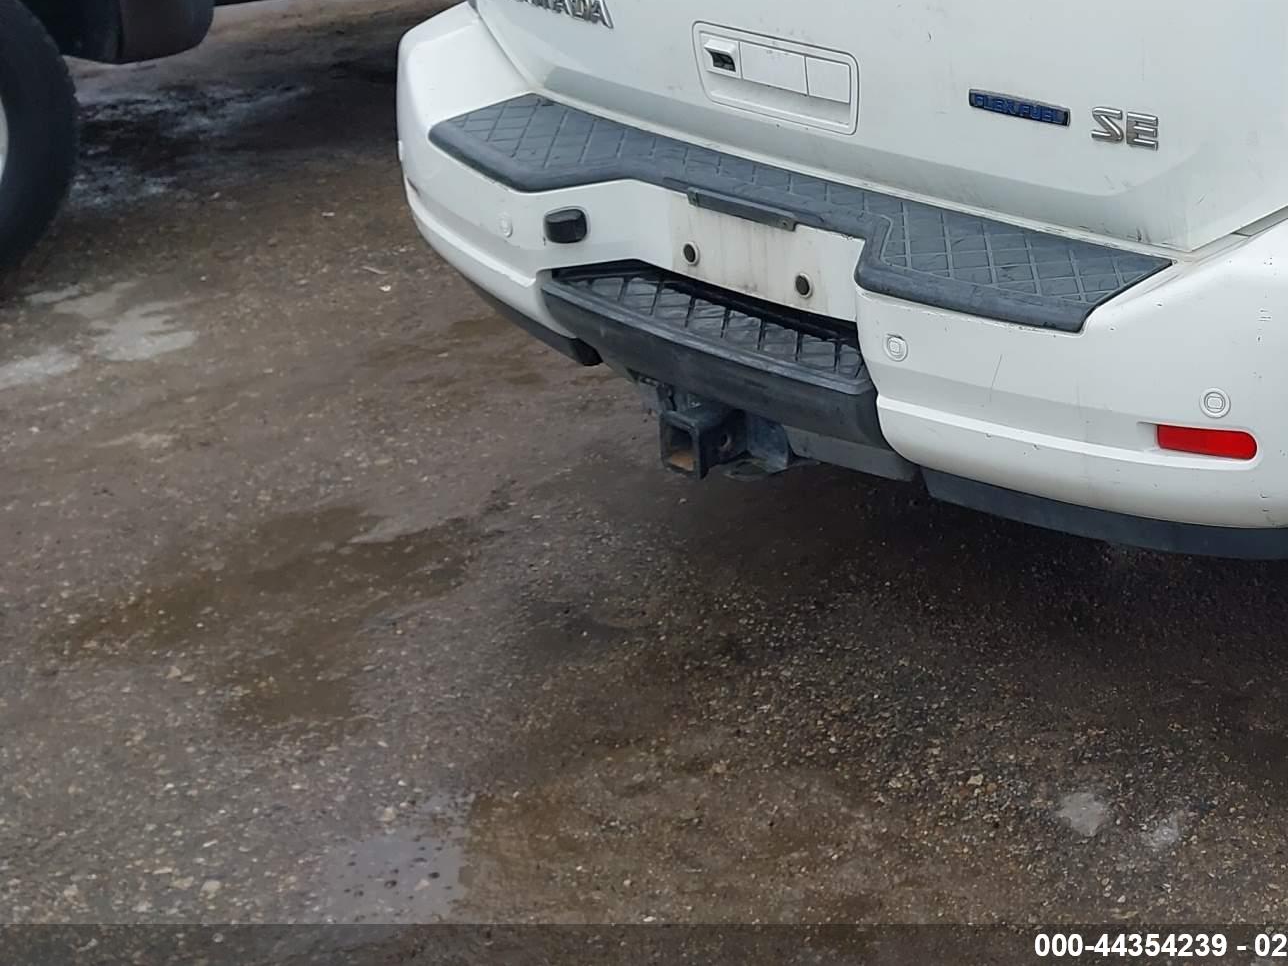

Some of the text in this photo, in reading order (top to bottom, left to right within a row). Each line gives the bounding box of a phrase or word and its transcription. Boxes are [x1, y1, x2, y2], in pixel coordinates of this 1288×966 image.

[973, 93, 1065, 125] FLEX FUEL
[1090, 106, 1159, 151] SE
